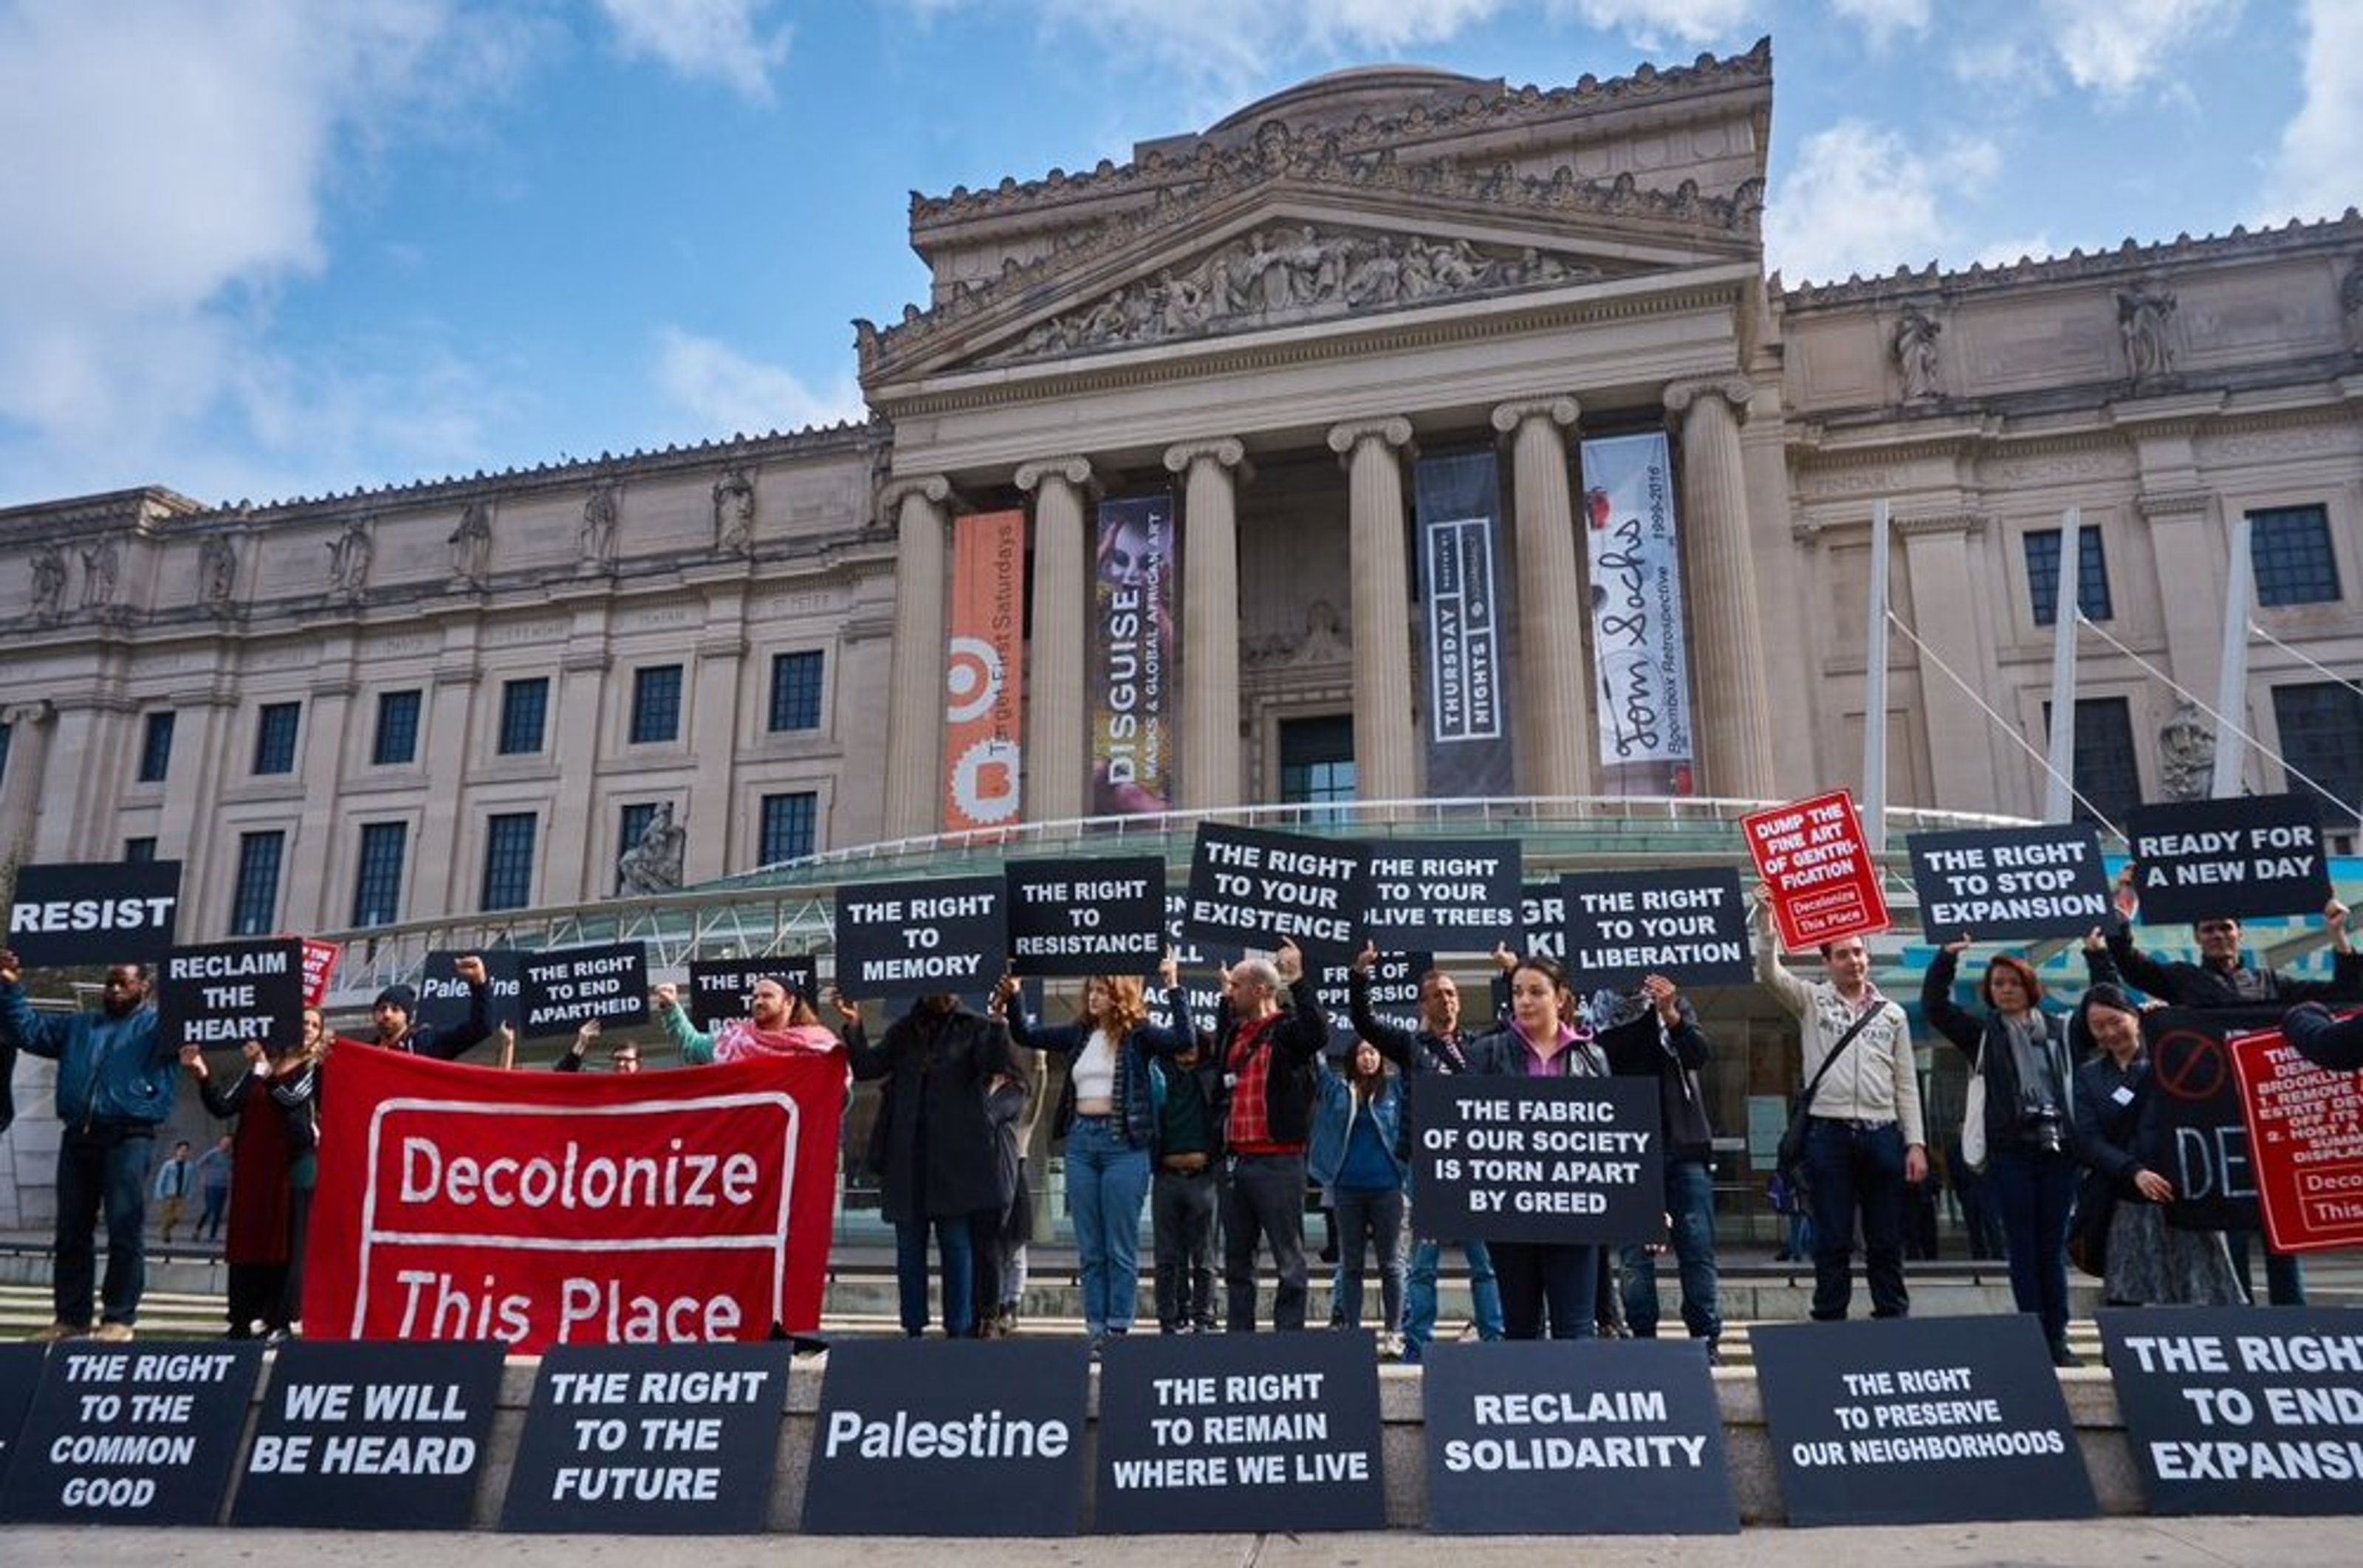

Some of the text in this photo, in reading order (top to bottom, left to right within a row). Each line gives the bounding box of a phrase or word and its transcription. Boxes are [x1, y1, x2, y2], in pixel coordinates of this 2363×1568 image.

[1148, 512, 1162, 546] ART
[992, 525, 1012, 627] Saturdays
[1146, 551, 1160, 623] AFRICAN
[1647, 465, 1681, 754] Boombox Retrospective 1999-2016
[992, 633, 1011, 680] First
[1145, 628, 1159, 695] GLOBAL
[1441, 608, 1459, 726] THURSDAY
[1109, 589, 1139, 784] DISGUISE
[1471, 643, 1489, 723] NIGHTS
[1757, 805, 1844, 838] DUMP THE
[1769, 823, 1843, 854] FINE ART
[2139, 826, 2314, 857] READY FOR
[1205, 842, 1357, 880] THE RIGHT
[1371, 859, 1498, 876] THE RIGHT
[1765, 839, 1859, 875] OF GENTRI-
[1924, 842, 2085, 871] THE RIGHT
[1781, 858, 1854, 890] FICATION
[1947, 869, 2075, 895] TO STOP
[2147, 856, 2314, 887] A NEW DAY
[1023, 881, 1147, 902] THE RIGHT
[1215, 873, 1337, 909] TO YOUR
[1377, 883, 1486, 900] TO YOUR
[1580, 888, 1724, 912] THE RIGHT
[1794, 890, 1856, 915] Decolonize
[10, 898, 174, 932] RESIST
[848, 895, 995, 923] THE RIGHT
[1069, 909, 1100, 927] TO
[1193, 901, 1351, 942] EXISTENCE
[1433, 908, 1512, 926] TREES
[1800, 909, 1861, 932] This Place
[1932, 894, 2106, 924] EXPANSION
[903, 928, 939, 949] TO
[1597, 916, 1716, 939] TO YOUR
[1017, 933, 1158, 954] RESISTANCE
[1580, 942, 1740, 969] LIBERATION
[171, 952, 287, 979] RECLAIM
[528, 956, 635, 983] THE RIGHT
[863, 954, 981, 980] MEMORY
[1323, 963, 1410, 983] FRE OF
[203, 985, 255, 1008] THE
[546, 979, 620, 1000] TO END
[699, 974, 738, 990] THE
[529, 997, 640, 1023] APARTHEID
[740, 995, 753, 1011] T
[185, 1017, 274, 1041] HEART
[2257, 1070, 2353, 1095] BROOKLYN
[2277, 1082, 2353, 1105] REMOVE
[1456, 1100, 1613, 1122] THE FABRIC
[2258, 1100, 2327, 1121] ESTATE
[2289, 1113, 2324, 1128] OFF
[1424, 1129, 1649, 1153] OF OUR SOCIETY
[2290, 1124, 2340, 1141] HOST
[2347, 1121, 2359, 1134] A
[2308, 1134, 2363, 1149] SUMM
[399, 1136, 758, 1210] Decolonize
[1436, 1159, 1640, 1183] IS TORN APART
[2176, 1127, 2258, 1200] DE
[2306, 1175, 2363, 1192] Deco
[1470, 1190, 1606, 1213] BY GREED
[397, 1269, 741, 1344] This Place
[68, 1355, 235, 1381] THE RIGHT
[2124, 1336, 2363, 1372] THE RIGH
[551, 1372, 768, 1403] THE RIGHT
[1153, 1374, 1323, 1405] THE RIGHT
[1843, 1368, 1971, 1396] THE RIGHT
[81, 1395, 193, 1422] TO THE
[286, 1385, 466, 1420] WE WILL
[1475, 1392, 1667, 1424] RECLAIM
[1834, 1400, 2002, 1430] TO PRESERVE
[2183, 1388, 2363, 1425] TO END
[575, 1419, 721, 1451] TO THE
[826, 1410, 1069, 1457] Palestine
[1151, 1413, 1327, 1445] TO REMAIN
[51, 1436, 196, 1464] COMMON
[250, 1437, 475, 1474] BE HEARD
[1446, 1436, 1706, 1471] SOLIDARITY
[1793, 1430, 2064, 1466] OUR NEIGHBORHOODS
[2150, 1442, 2363, 1479] EXPANSI
[553, 1468, 721, 1500] FUTURE
[1114, 1452, 1368, 1488] WHERE WE LIVE
[63, 1478, 155, 1507] GOOD
